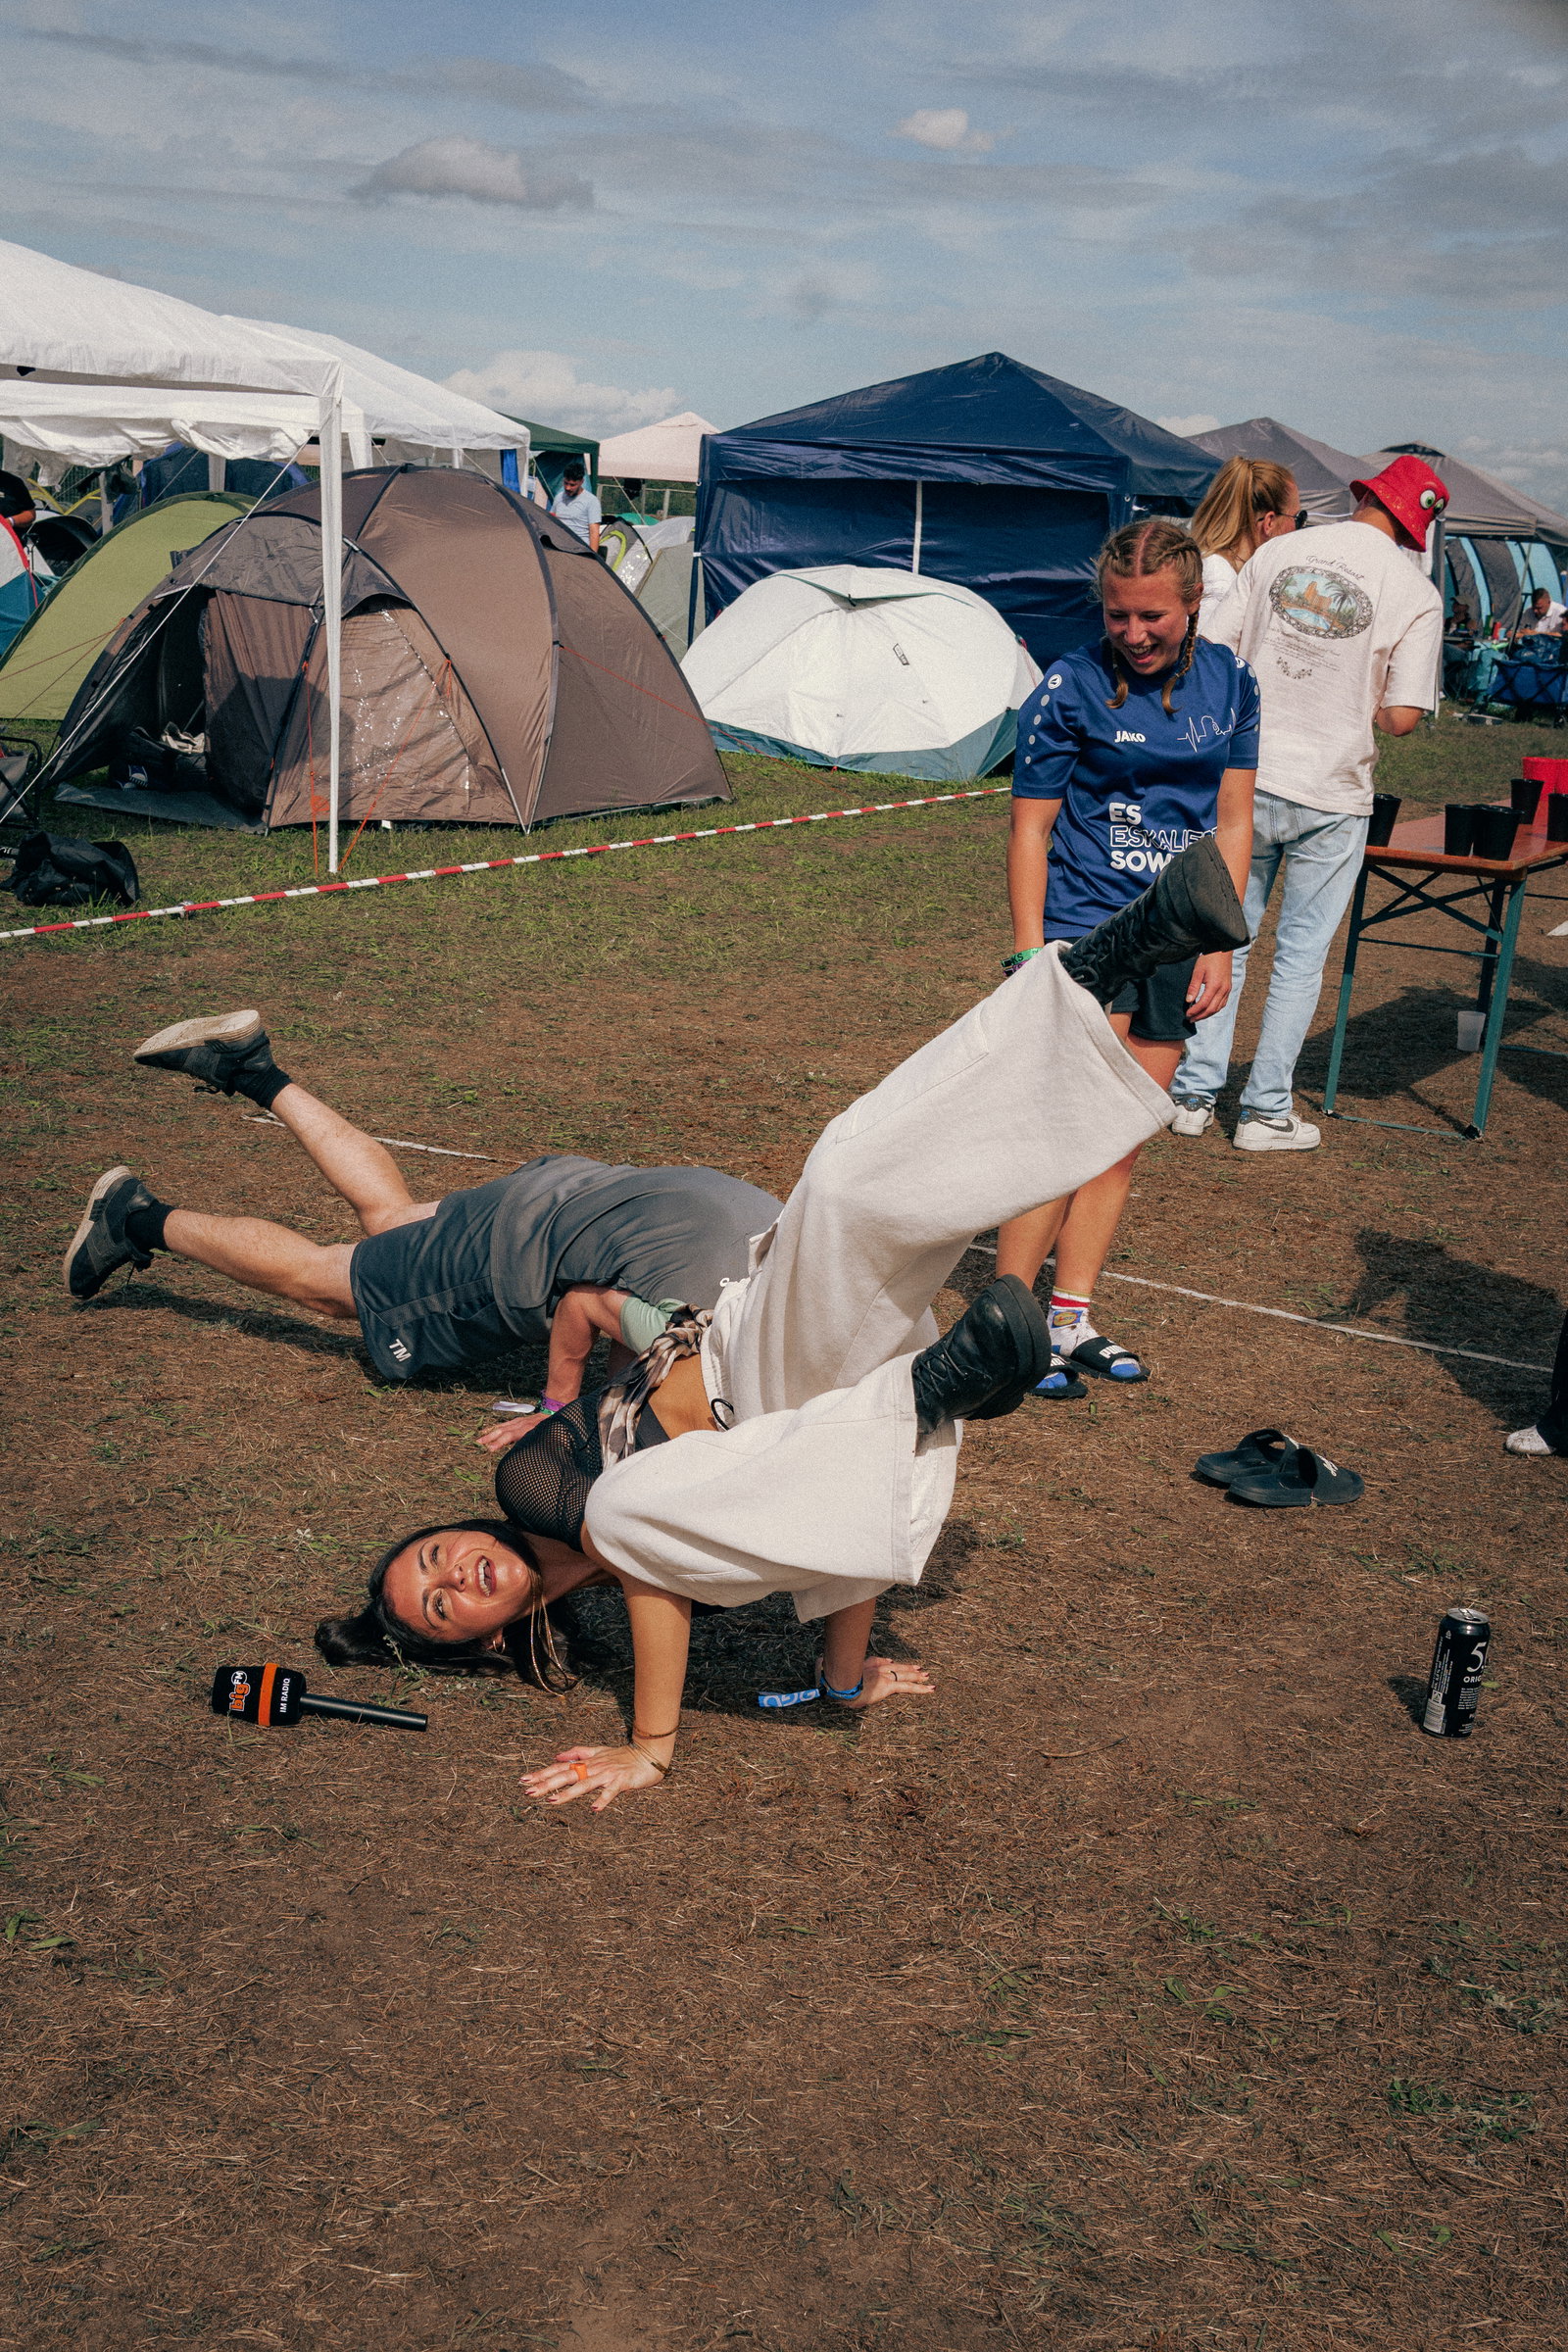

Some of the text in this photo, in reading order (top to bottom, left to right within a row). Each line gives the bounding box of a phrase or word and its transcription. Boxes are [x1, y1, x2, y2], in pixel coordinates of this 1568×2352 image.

[1114, 730, 1147, 743] JAKO
[1108, 802, 1142, 825] ES
[1109, 825, 1218, 853] ESKALIE
[1109, 850, 1175, 873] SOW
[389, 1338, 412, 1362] TM
[280, 1678, 290, 1701] RADIO
